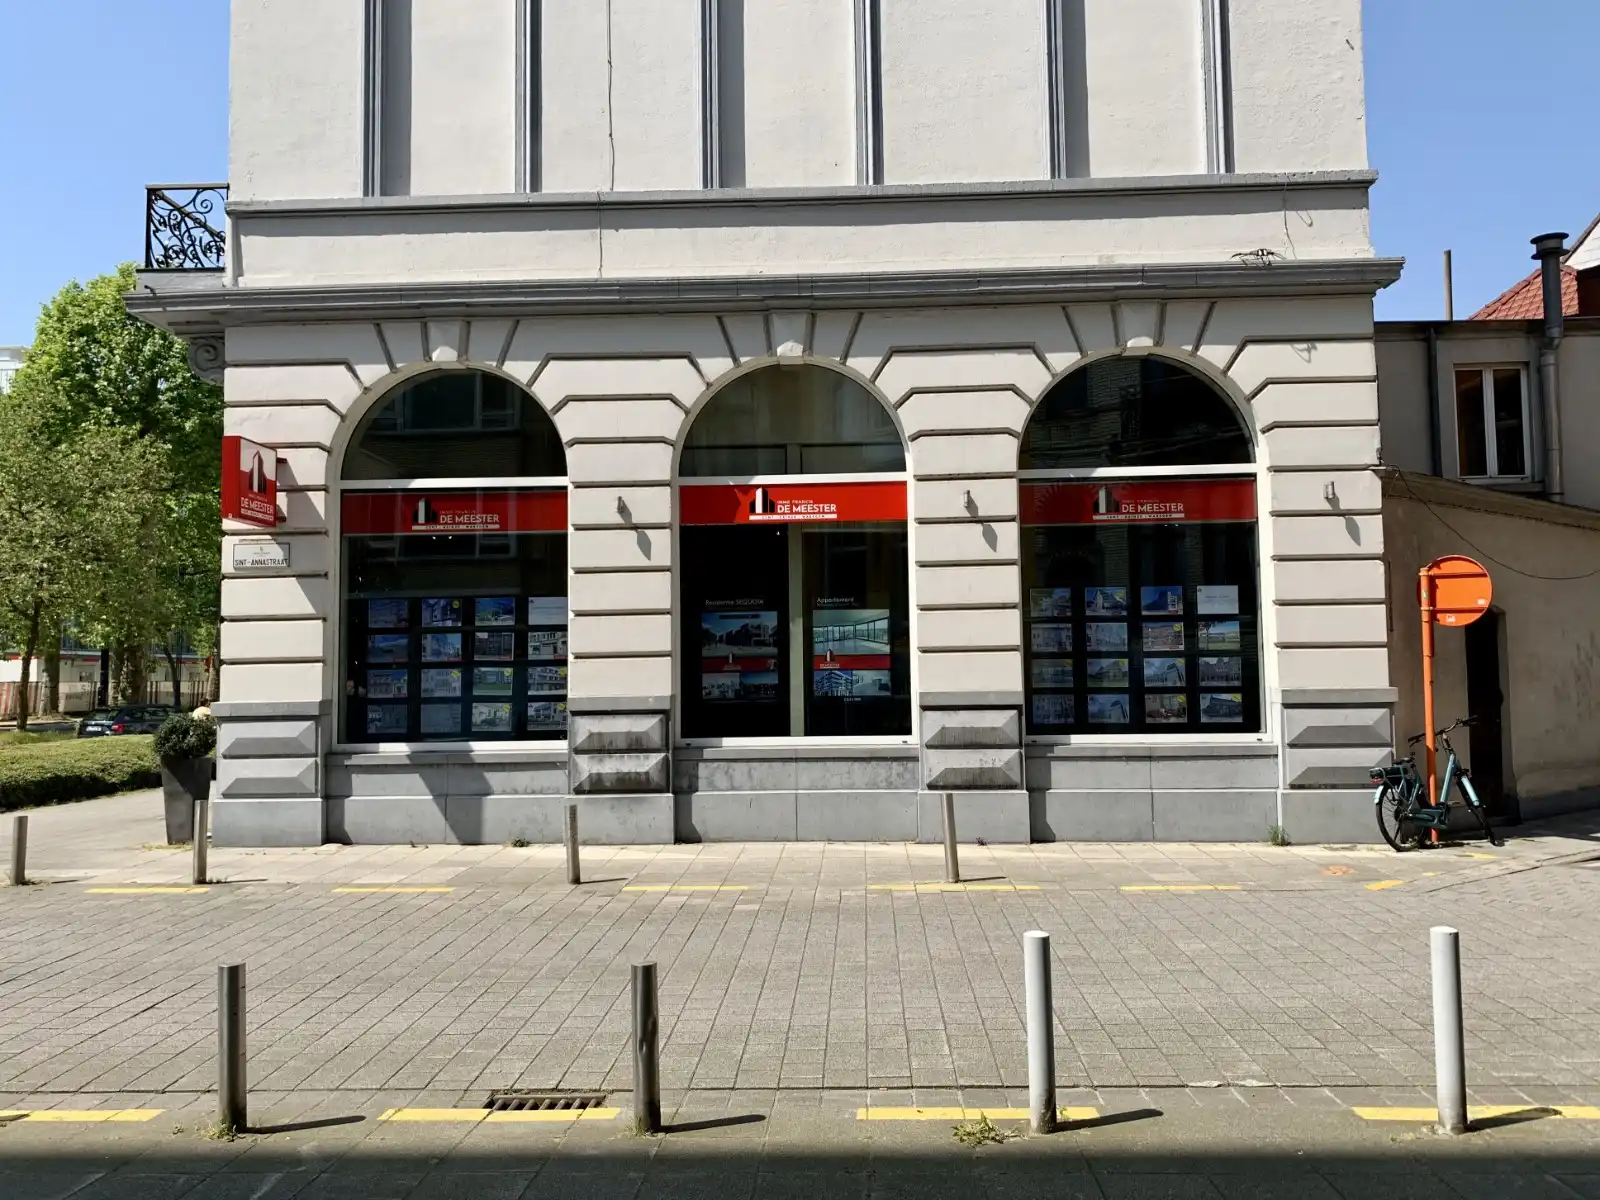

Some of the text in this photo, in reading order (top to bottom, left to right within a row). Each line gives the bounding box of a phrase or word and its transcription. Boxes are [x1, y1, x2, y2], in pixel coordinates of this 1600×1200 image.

[241, 497, 249, 508] DE
[249, 500, 274, 515] MEESTER
[776, 503, 837, 514] DE MEESTER
[1121, 502, 1184, 513] DE MEESTER
[440, 513, 500, 523] DE MEESTER
[234, 558, 289, 567] SINT-ANNASTRAAT
